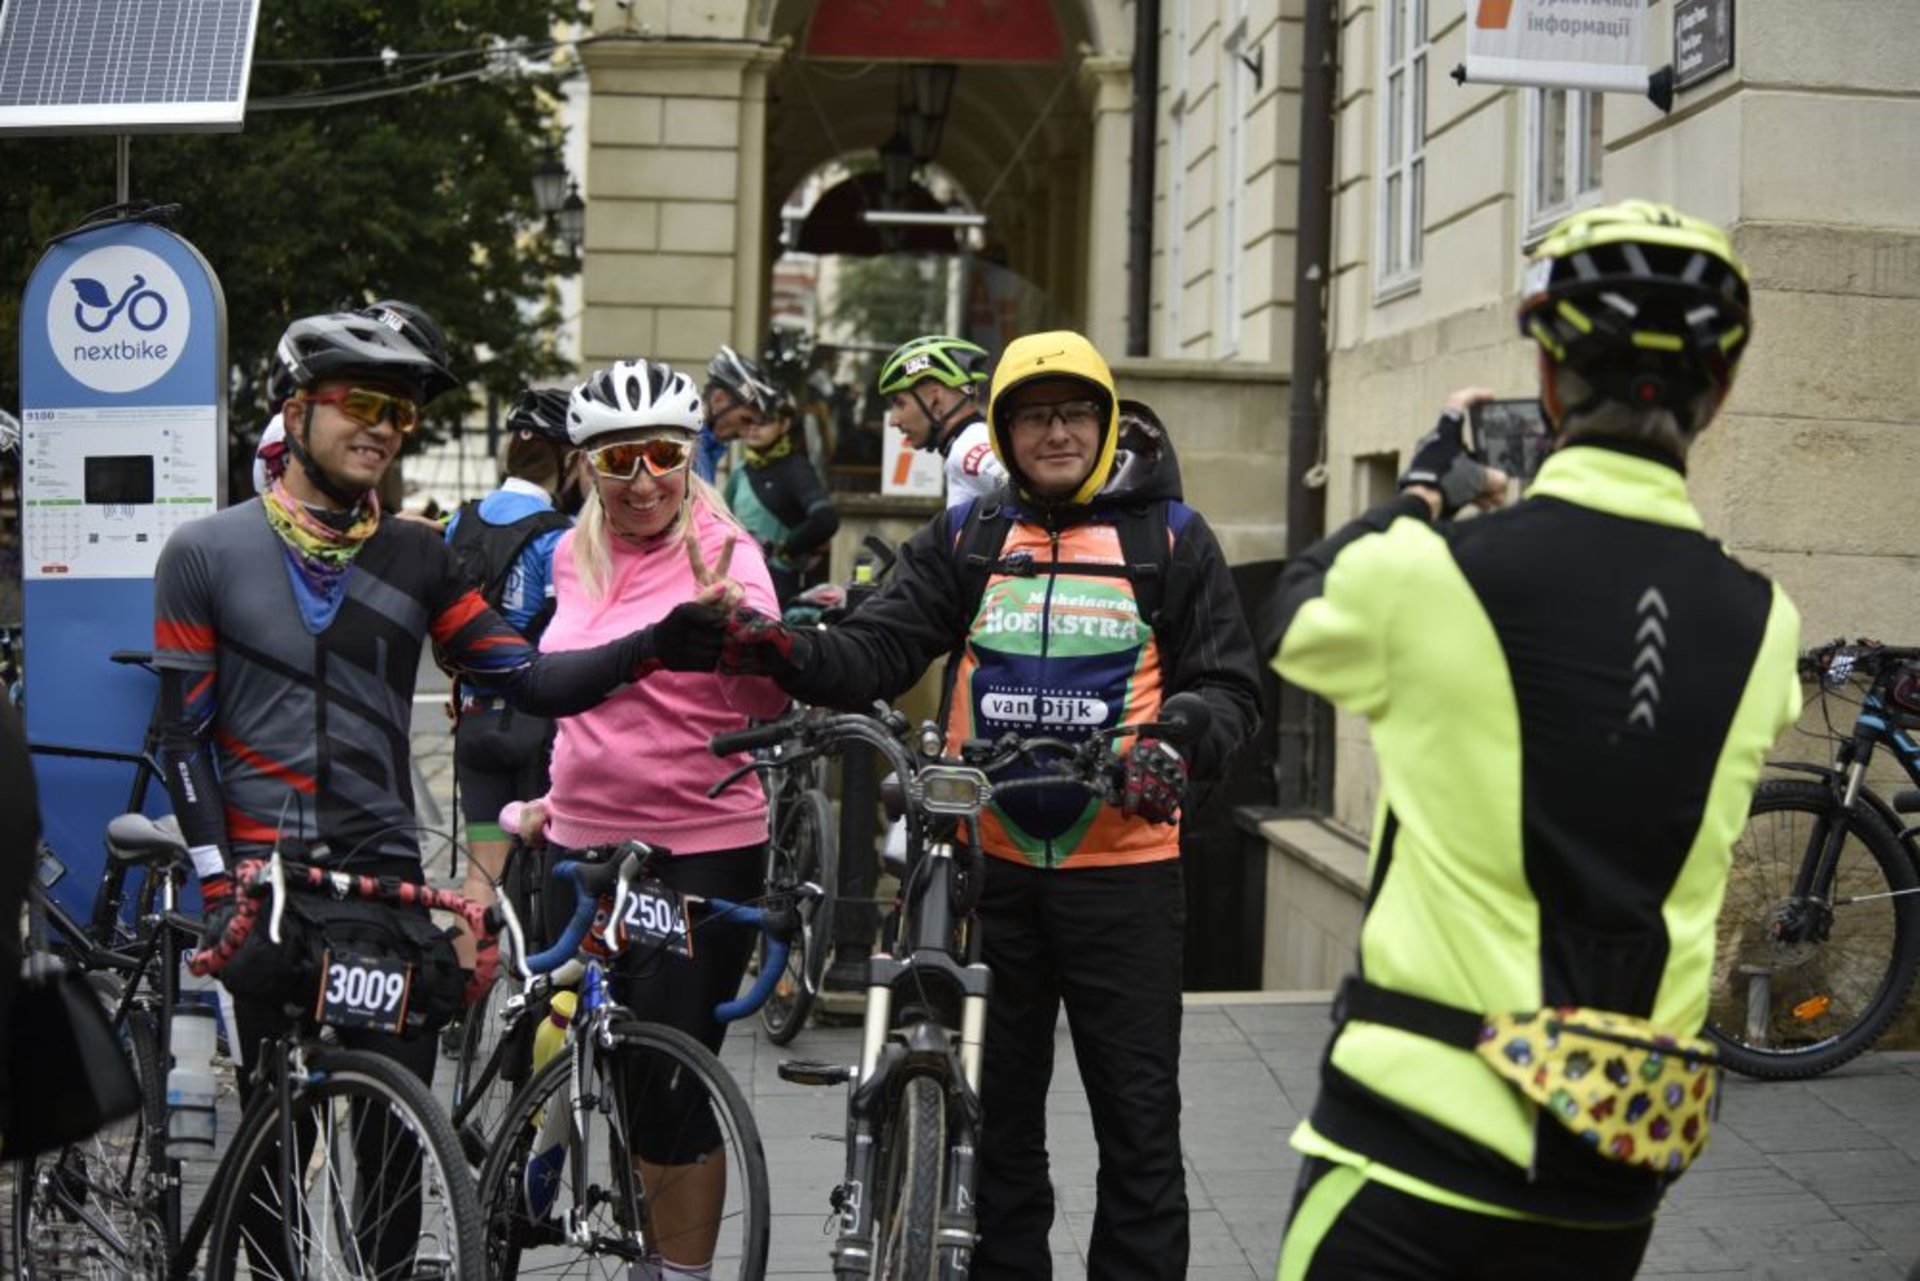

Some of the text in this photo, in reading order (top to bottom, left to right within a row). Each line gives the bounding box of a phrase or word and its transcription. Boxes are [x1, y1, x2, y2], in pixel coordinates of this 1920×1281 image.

[1527, 13, 1630, 38] інформації
[73, 339, 168, 361] nextbike
[326, 963, 404, 1012] 3009
